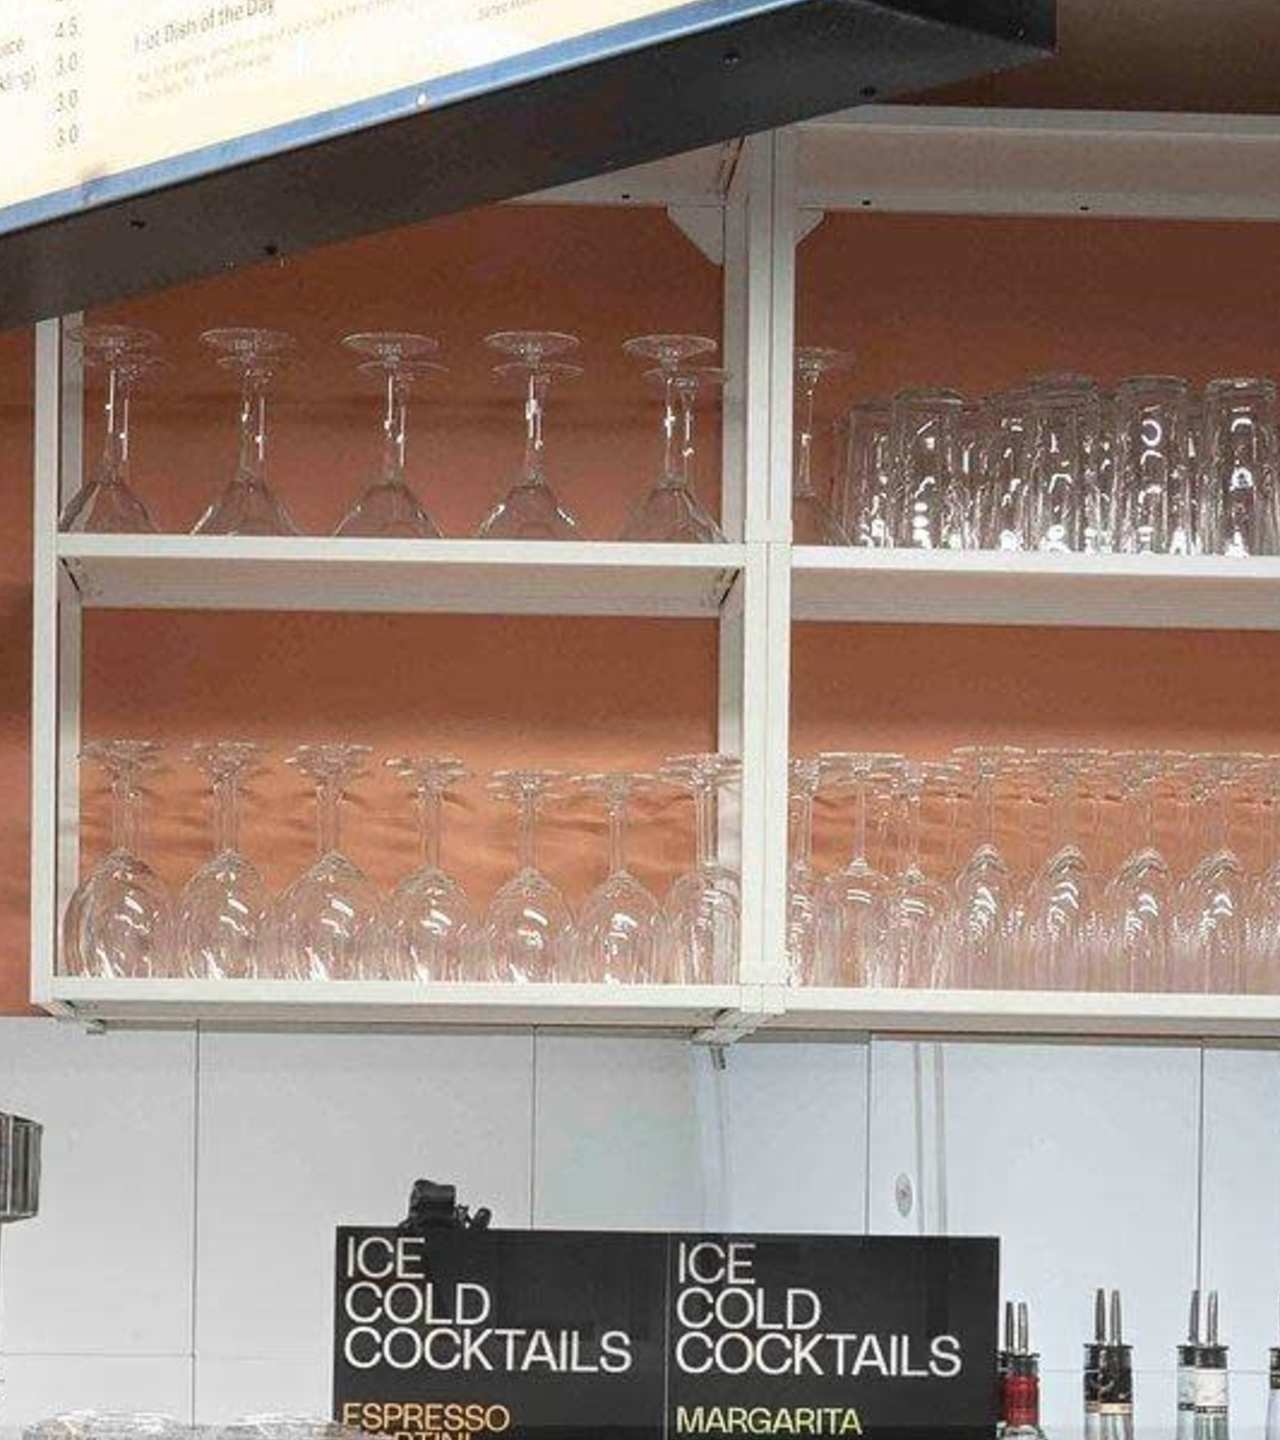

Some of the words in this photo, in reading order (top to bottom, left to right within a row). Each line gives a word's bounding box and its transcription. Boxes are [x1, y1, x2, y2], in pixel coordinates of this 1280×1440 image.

[346, 1237, 426, 1281] ICE
[677, 1243, 756, 1285] ICE
[344, 1282, 491, 1327] COLD
[676, 1288, 821, 1331] COLD
[344, 1328, 632, 1373] COCKTAILS
[675, 1333, 962, 1377] COCKTAILS
[342, 1402, 511, 1432] ESPRESSO
[676, 1406, 863, 1435] MARGARITA
